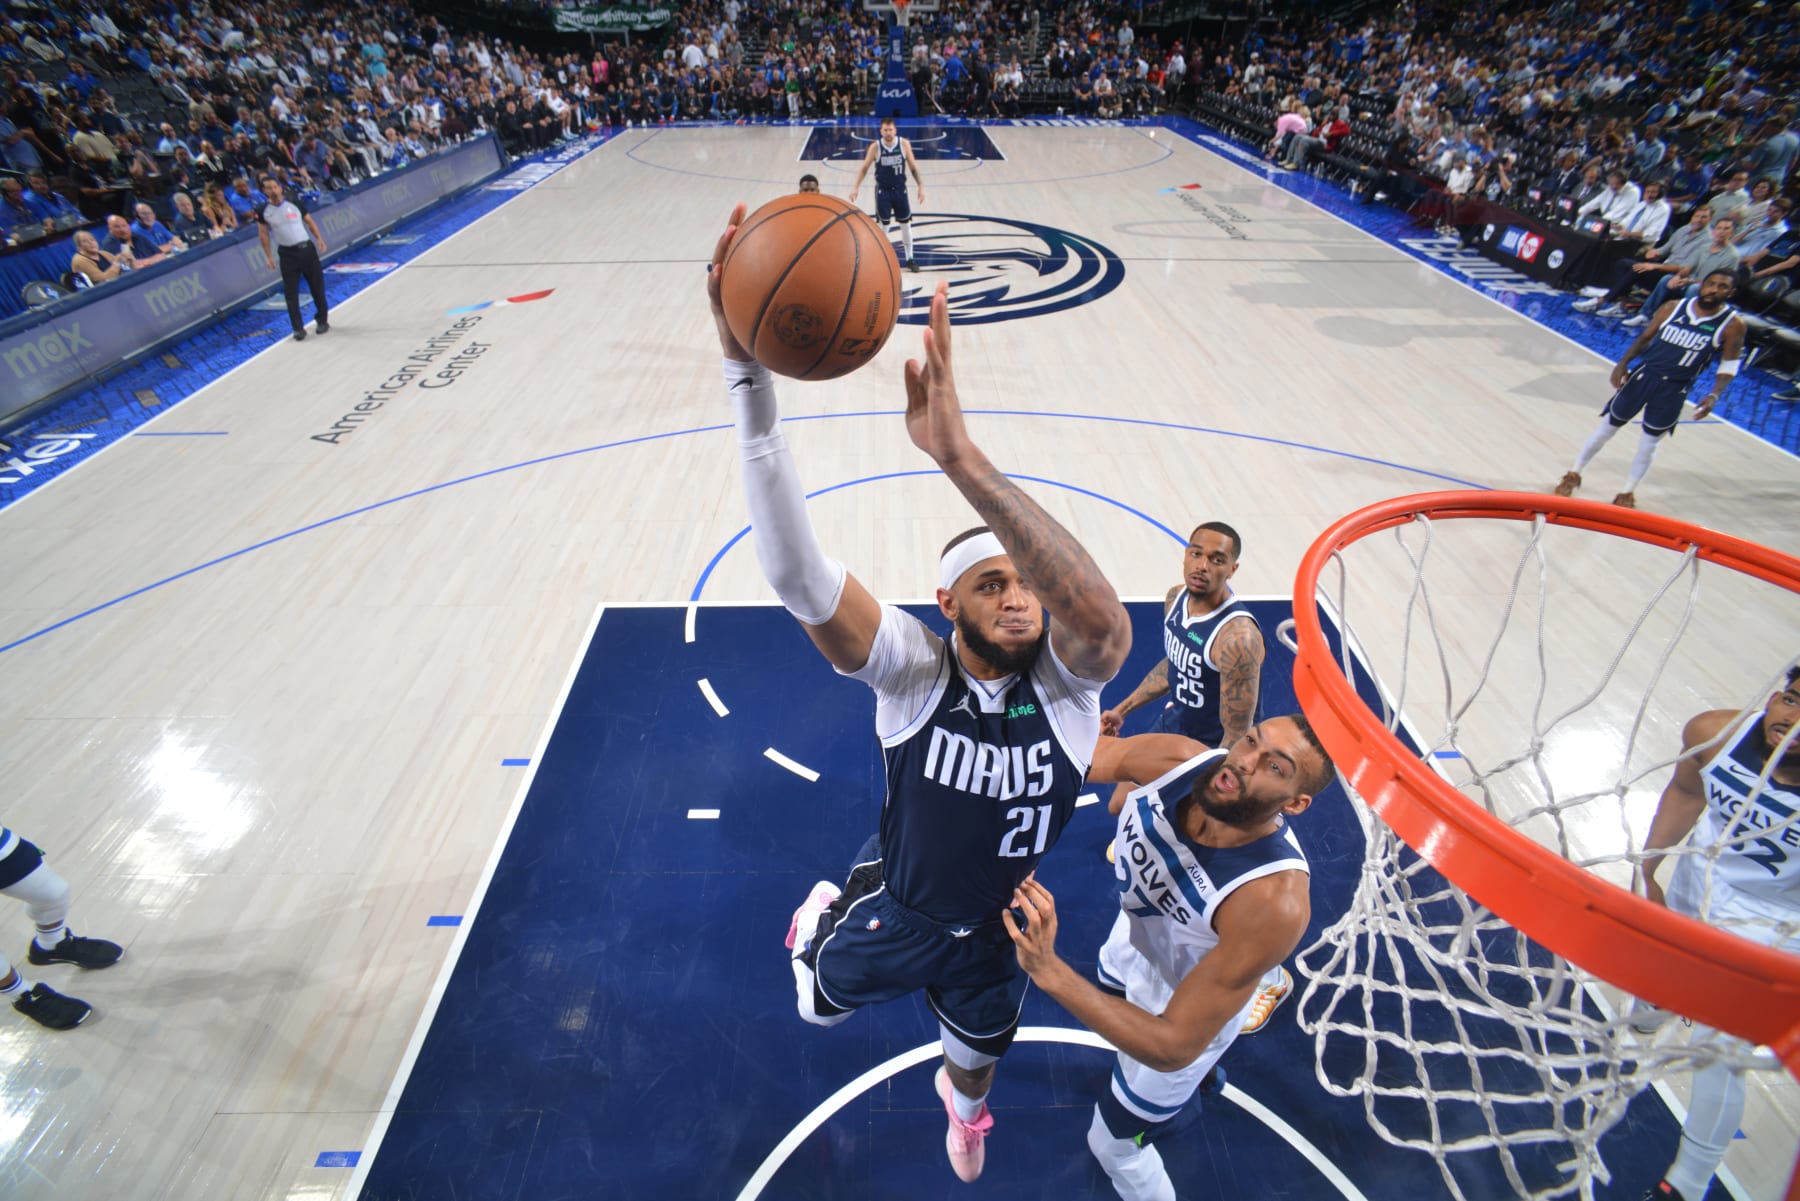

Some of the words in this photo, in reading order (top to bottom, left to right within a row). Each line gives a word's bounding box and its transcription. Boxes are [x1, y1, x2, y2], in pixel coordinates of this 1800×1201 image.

[882, 88, 911, 98] KIA
[893, 165, 902, 175] 77
[321, 202, 359, 236] max
[1550, 253, 1563, 265] TNT
[144, 271, 209, 316] max
[2, 321, 94, 378] max
[1660, 324, 1712, 351] MAVS
[1678, 350, 1700, 367] 11
[310, 363, 428, 444] American
[408, 315, 483, 363] Airlines
[418, 340, 492, 390] Center
[1164, 624, 1202, 679] MAVS
[1176, 671, 1204, 708] 25
[924, 725, 1053, 801] MAVS
[998, 804, 1053, 858] 21
[1122, 813, 1192, 926] WOLVES
